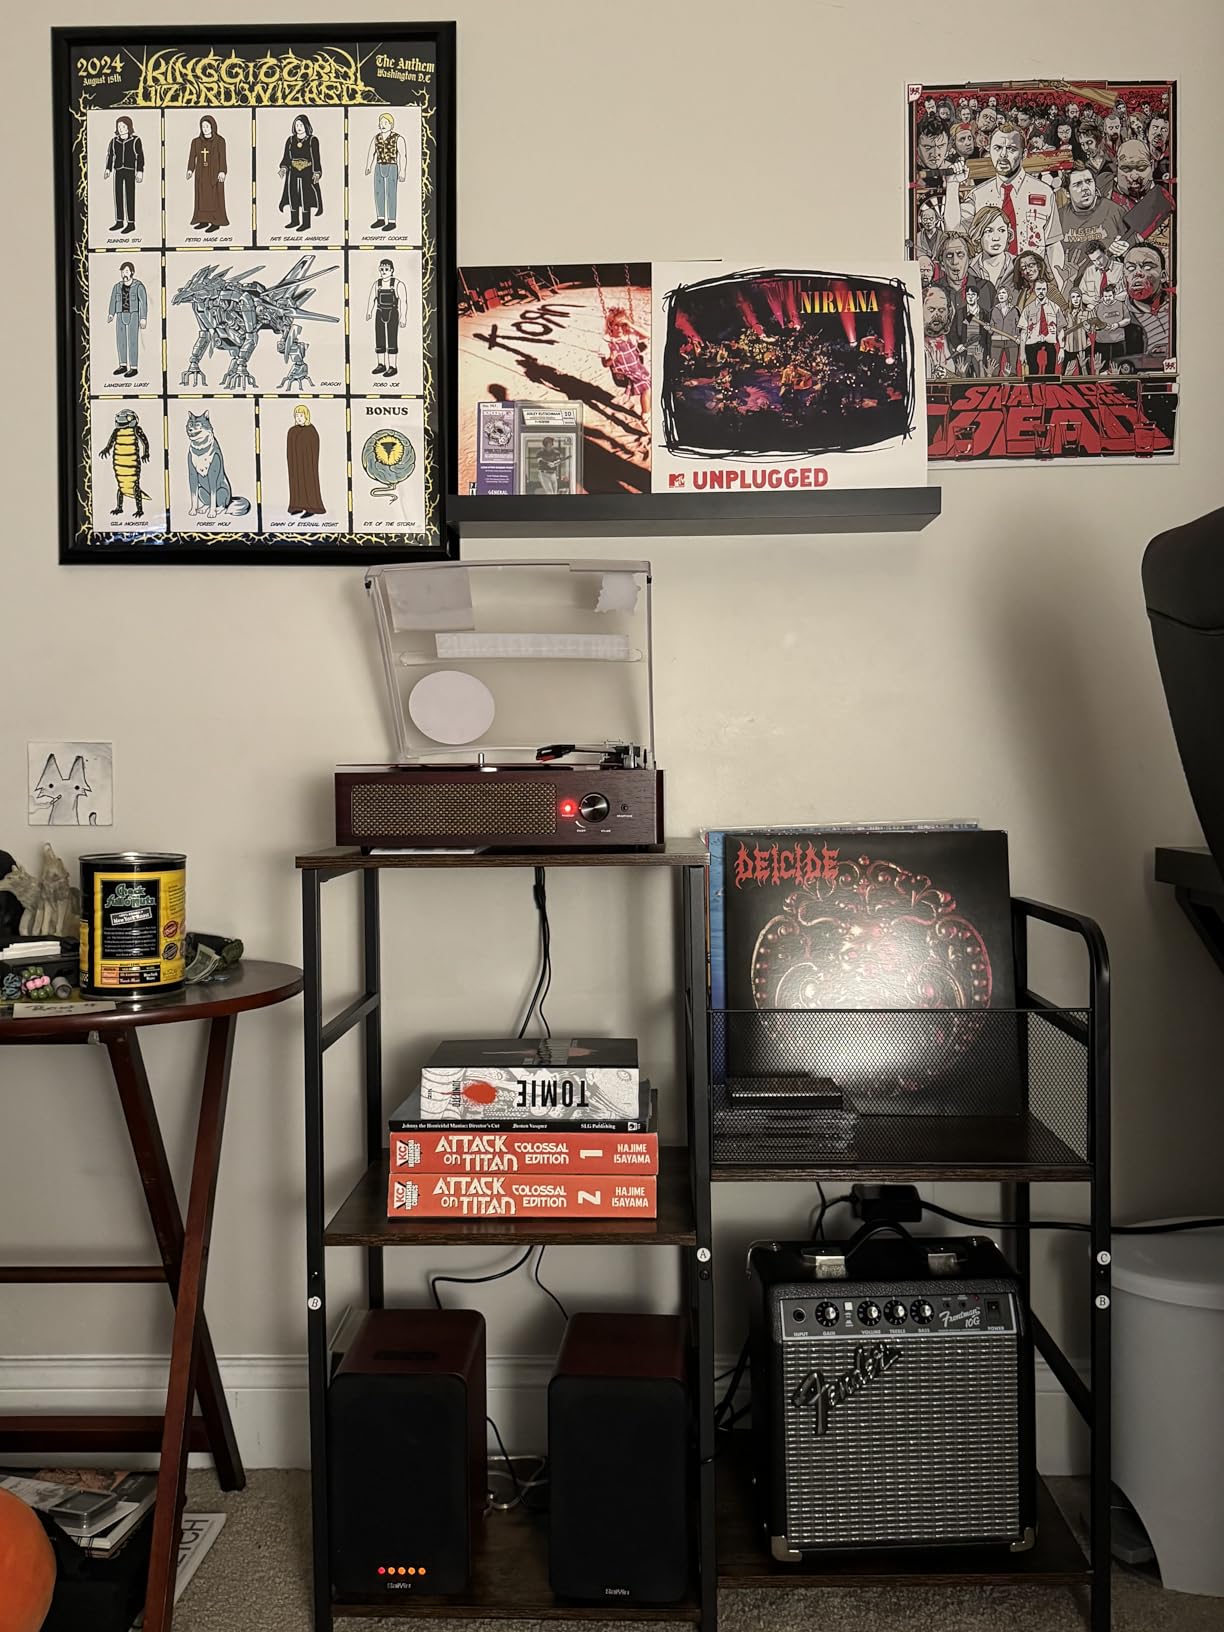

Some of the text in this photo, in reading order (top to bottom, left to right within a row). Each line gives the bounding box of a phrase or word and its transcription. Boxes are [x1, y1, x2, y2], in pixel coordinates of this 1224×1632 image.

[77, 53, 125, 77] 2024
[375, 54, 435, 73] The Anthem
[83, 74, 122, 87] August 15th
[376, 68, 417, 82] Washington
[800, 289, 879, 314] NIRVANA
[952, 383, 1091, 411] SHAUN
[366, 406, 409, 416] BONUS
[692, 467, 829, 490] UNPLUGGED
[734, 840, 840, 890] DEICIDE
[516, 1079, 589, 1108] TOMIE
[435, 1135, 509, 1153] ATTACK
[514, 1142, 569, 1153] COLOSSAL
[617, 1143, 648, 1153] HAJIME
[398, 1145, 407, 1161] KC
[525, 1154, 569, 1165] EDITION
[580, 1149, 603, 1160] 1
[613, 1154, 651, 1164] ISAYAMA
[462, 1153, 519, 1172] TITAN
[432, 1177, 506, 1195] ATTACK
[512, 1185, 567, 1196] COLOSSAL
[615, 1186, 646, 1197] HAJIME
[396, 1187, 405, 1203] KC
[522, 1196, 567, 1208] EDITION
[577, 1190, 601, 1205] 2
[611, 1197, 649, 1208] ISAYAMA
[460, 1196, 516, 1215] TITAN
[939, 1307, 981, 1328] Frontman
[965, 1316, 980, 1328] 10G
[790, 1342, 902, 1435] Fender
